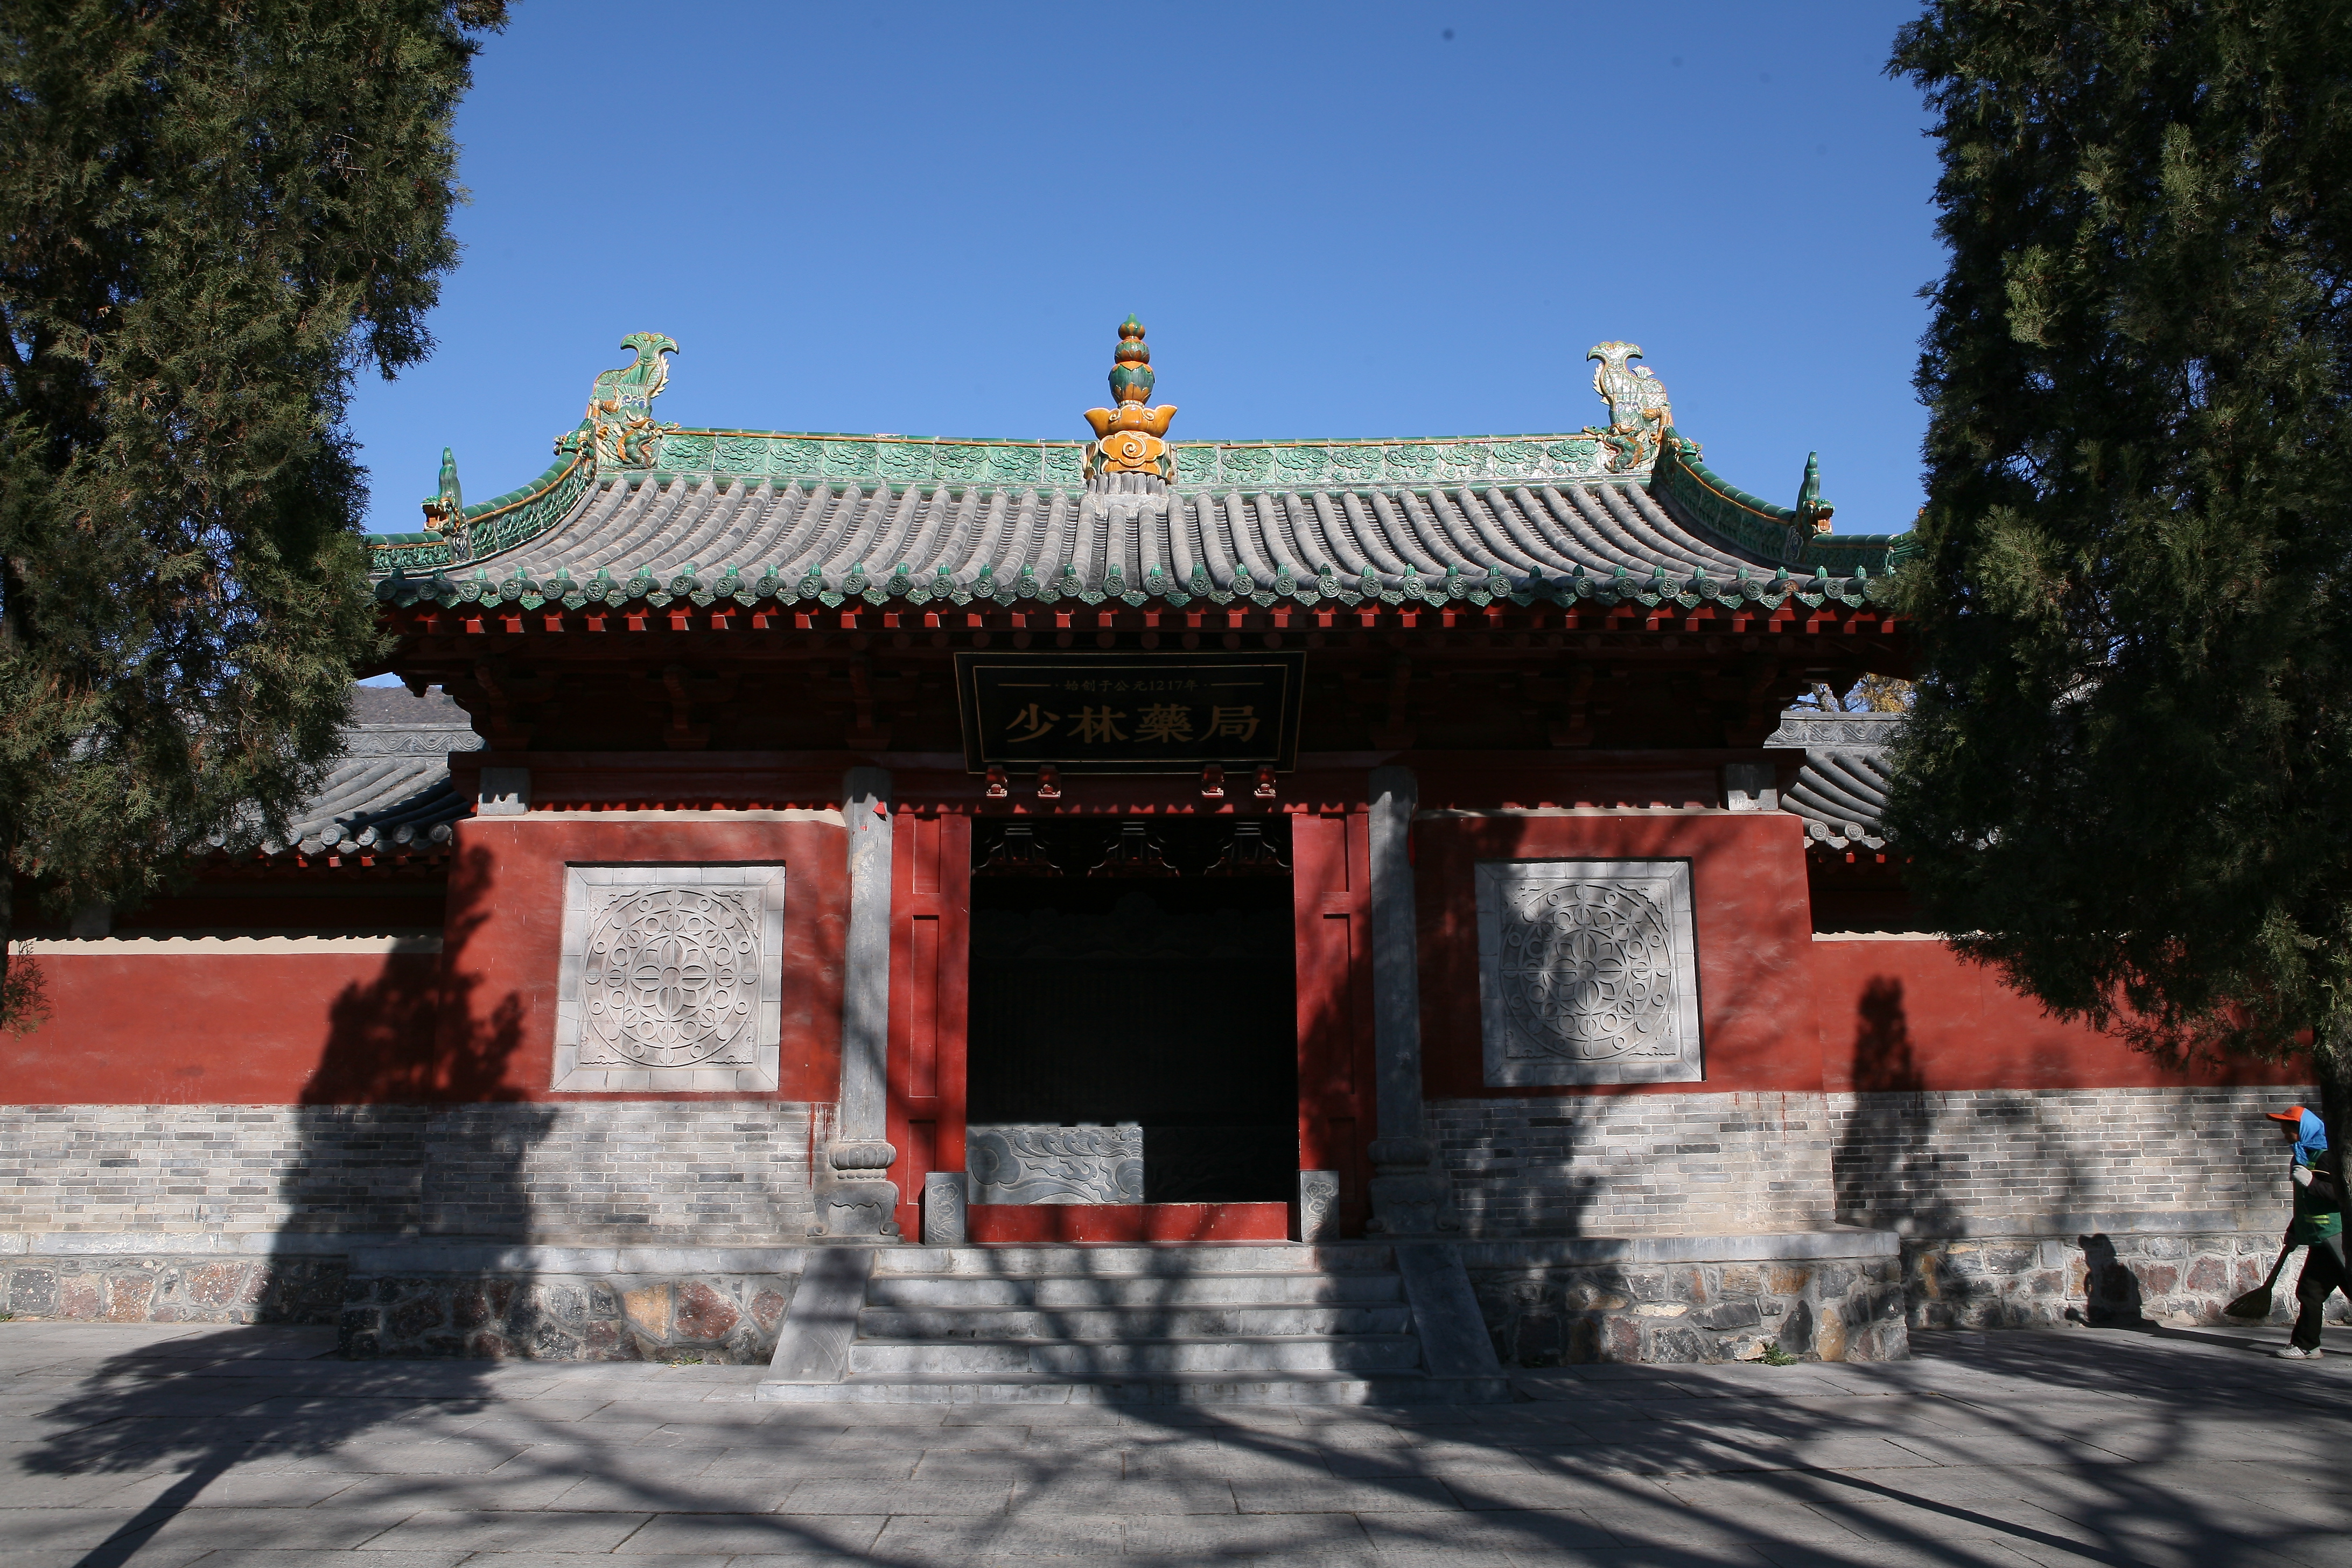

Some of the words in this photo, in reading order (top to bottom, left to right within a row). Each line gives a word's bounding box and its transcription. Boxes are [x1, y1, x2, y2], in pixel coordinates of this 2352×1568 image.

[1064, 679, 1199, 692] 始创于公元1217年
[1005, 703, 1261, 743] 少林藥局
